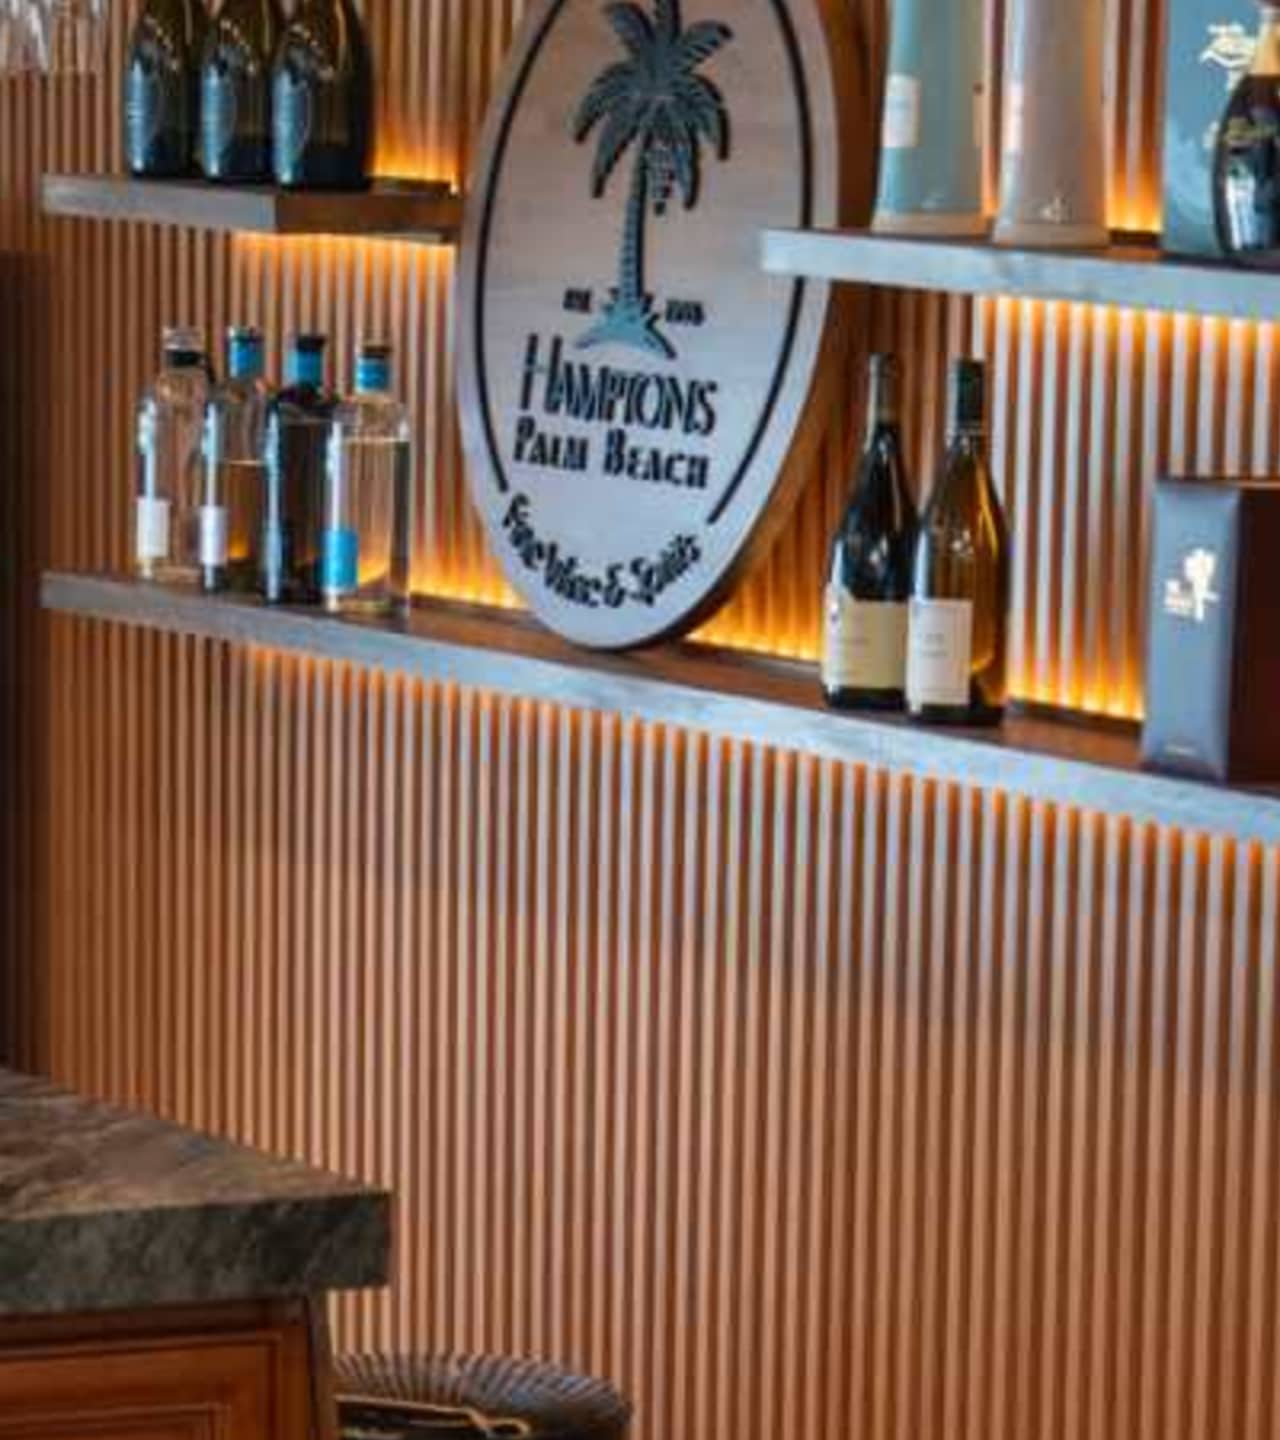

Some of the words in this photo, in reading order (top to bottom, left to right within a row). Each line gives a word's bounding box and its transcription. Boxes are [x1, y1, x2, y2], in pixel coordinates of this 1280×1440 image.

[521, 332, 719, 436] HAMPTONS
[514, 416, 589, 472] PALM
[603, 428, 710, 490] BEACH
